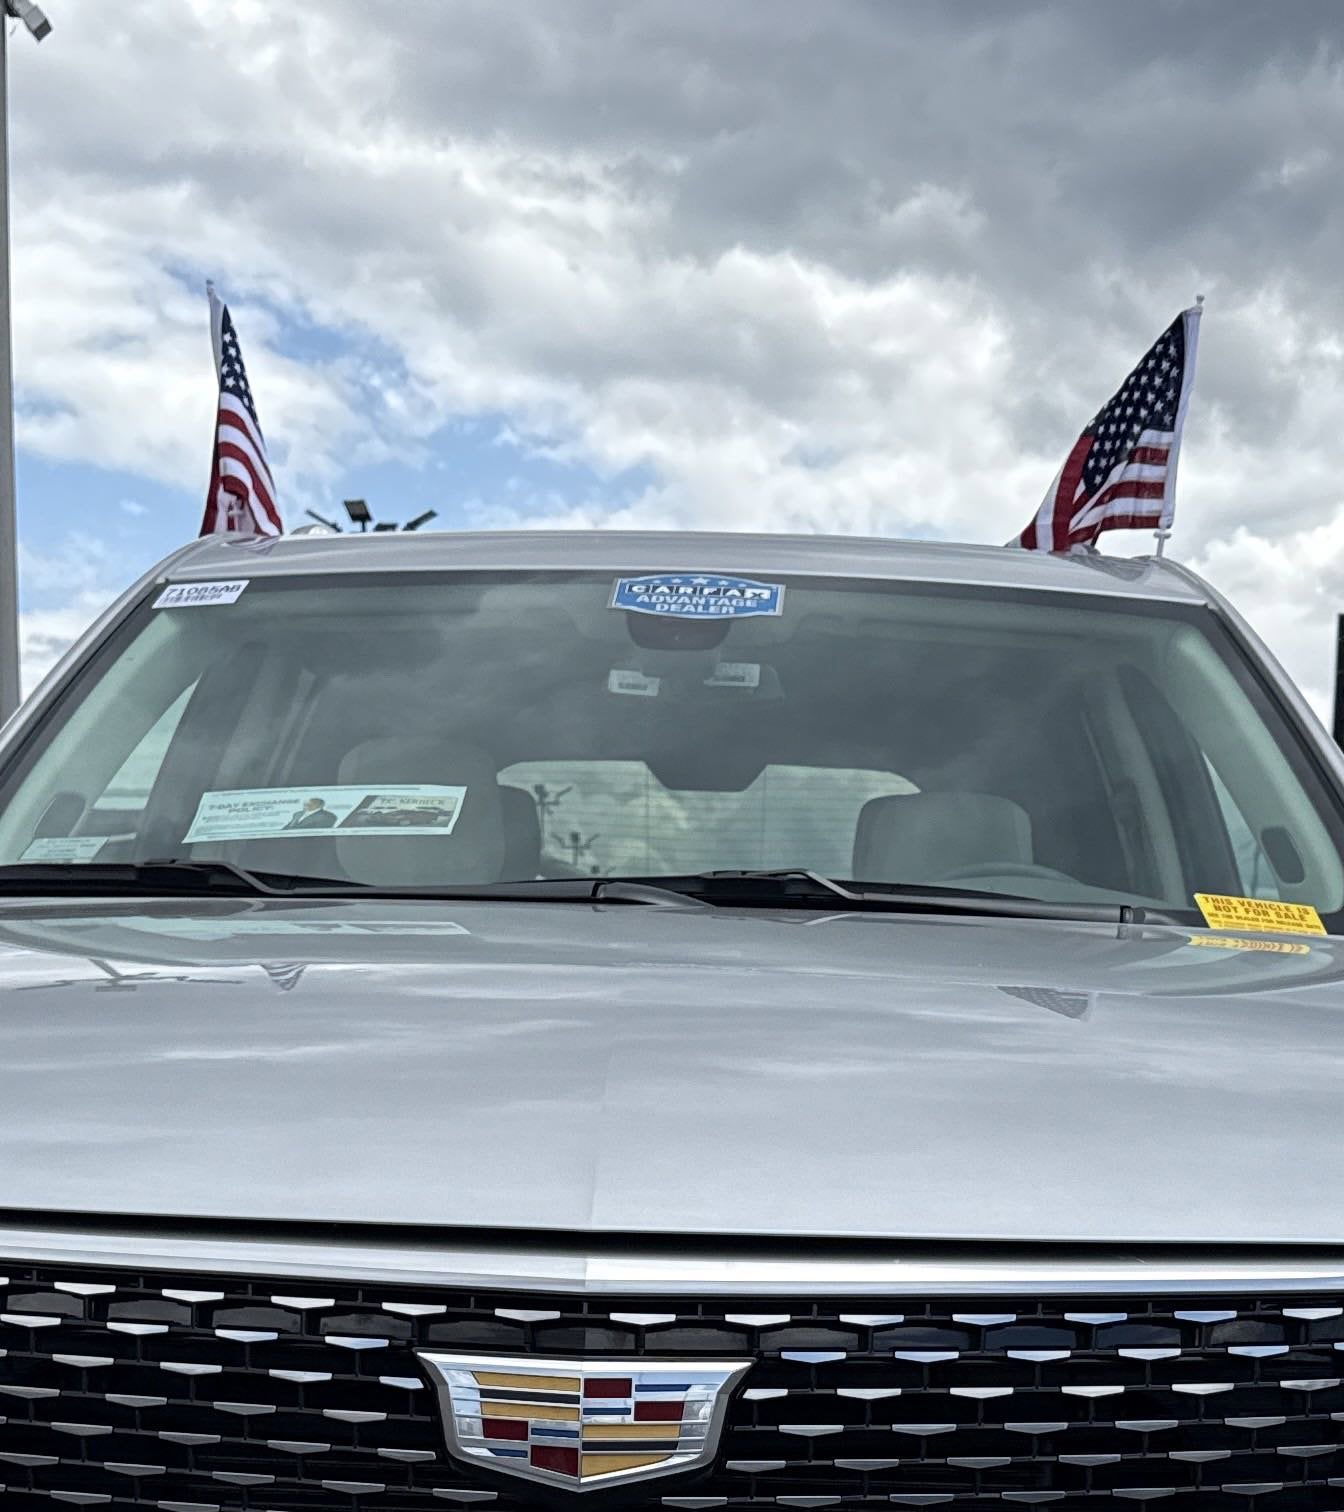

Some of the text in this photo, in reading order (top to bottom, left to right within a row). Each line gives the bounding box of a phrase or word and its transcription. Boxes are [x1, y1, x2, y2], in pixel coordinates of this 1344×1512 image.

[628, 584, 771, 600] CARFAX
[636, 595, 757, 608] ADVANTAGE
[655, 603, 736, 614] DEALER
[1203, 896, 1311, 916] THIS VEHICLE IS
[1213, 904, 1309, 922] NOT FOR SALE
